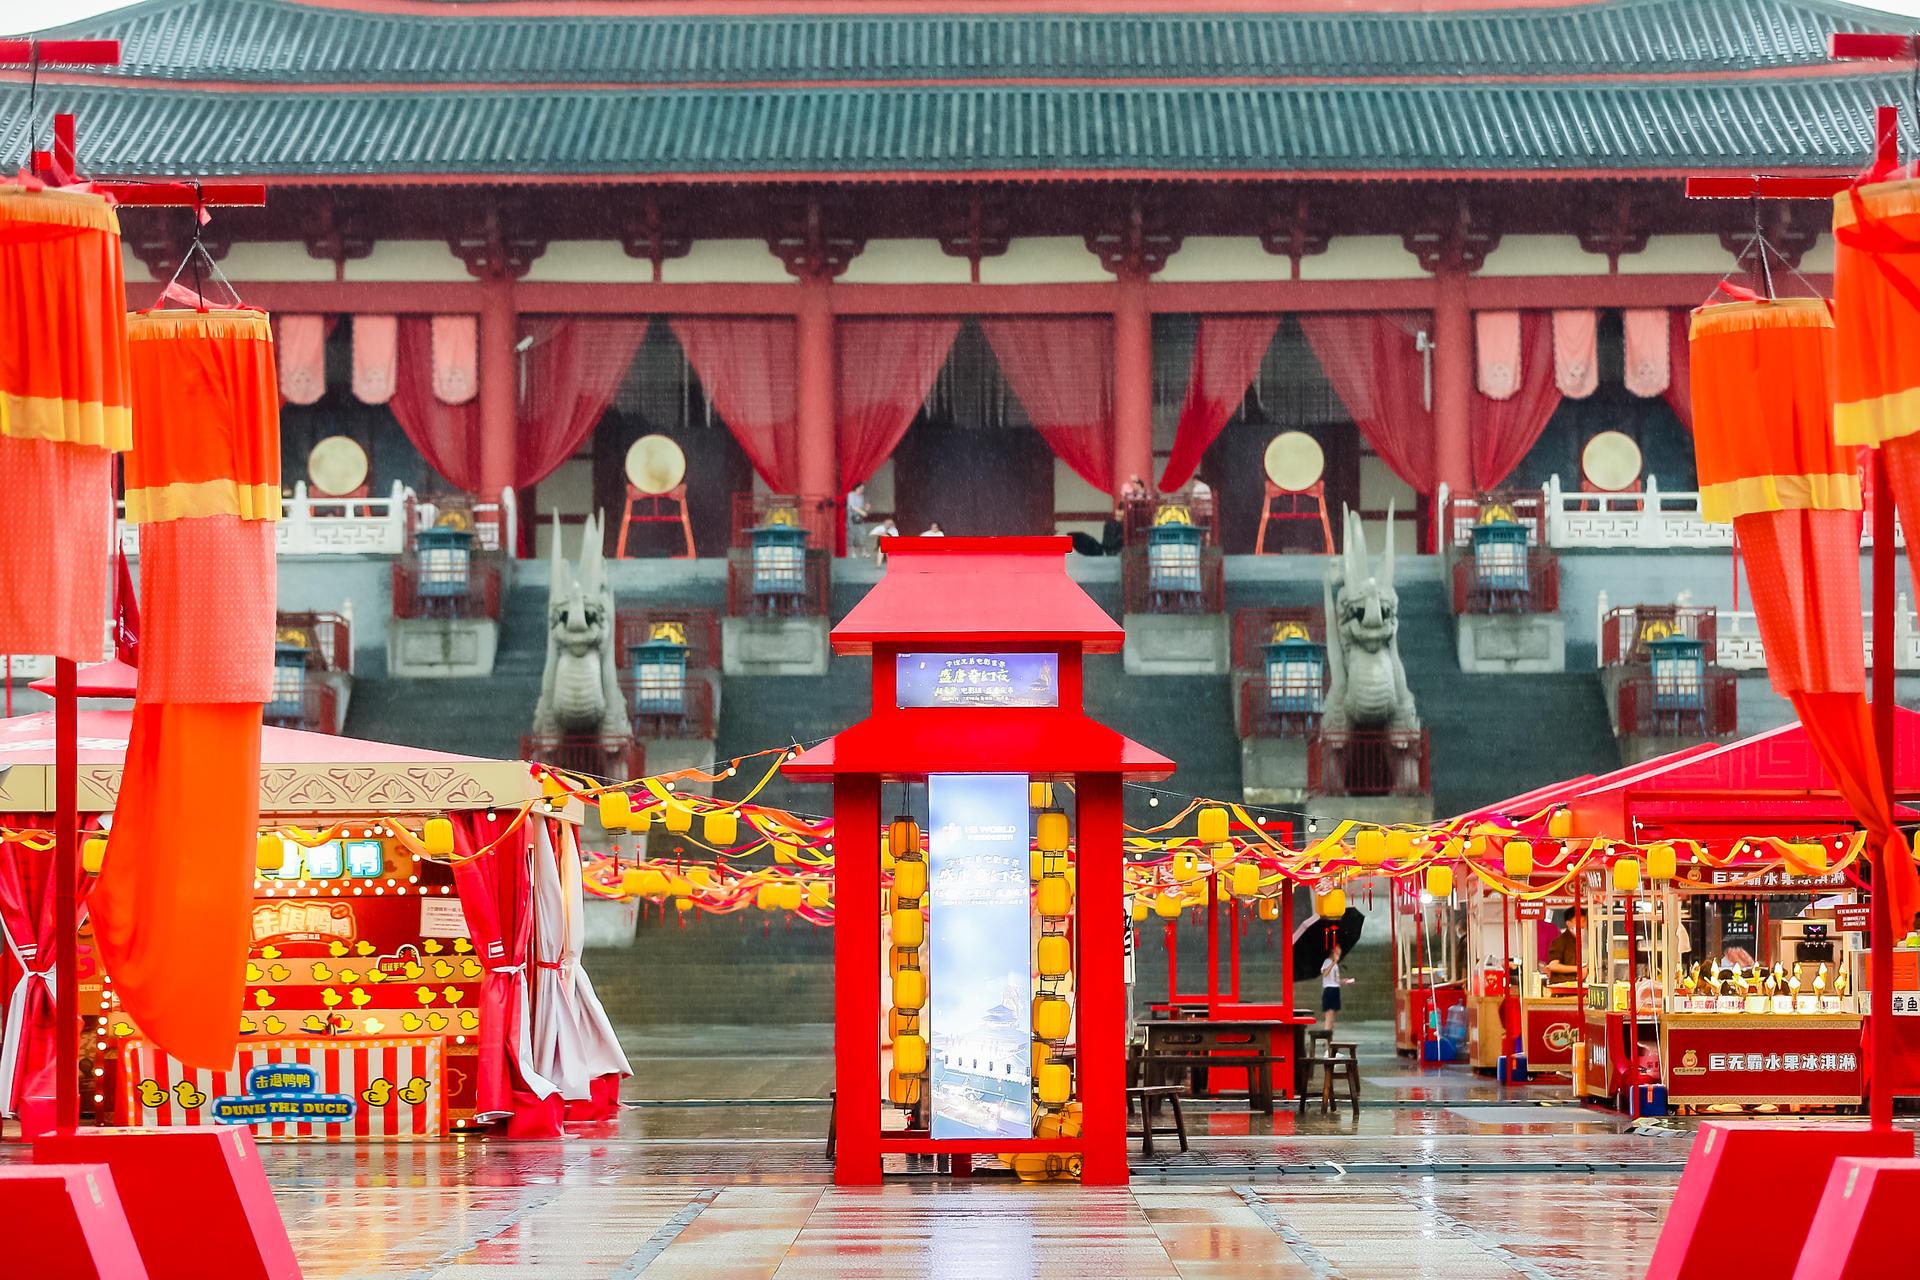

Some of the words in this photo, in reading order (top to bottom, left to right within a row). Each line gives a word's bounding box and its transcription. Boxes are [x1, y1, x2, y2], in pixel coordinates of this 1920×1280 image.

[1893, 996, 1918, 1012] 章鱼
[1709, 1054, 1857, 1071] 巨无霸水果冰淇淋
[256, 1073, 310, 1088] 击退鸭鸭
[221, 1104, 266, 1116] DUNK
[270, 1102, 299, 1113] THE
[303, 1103, 348, 1114] DUCK
